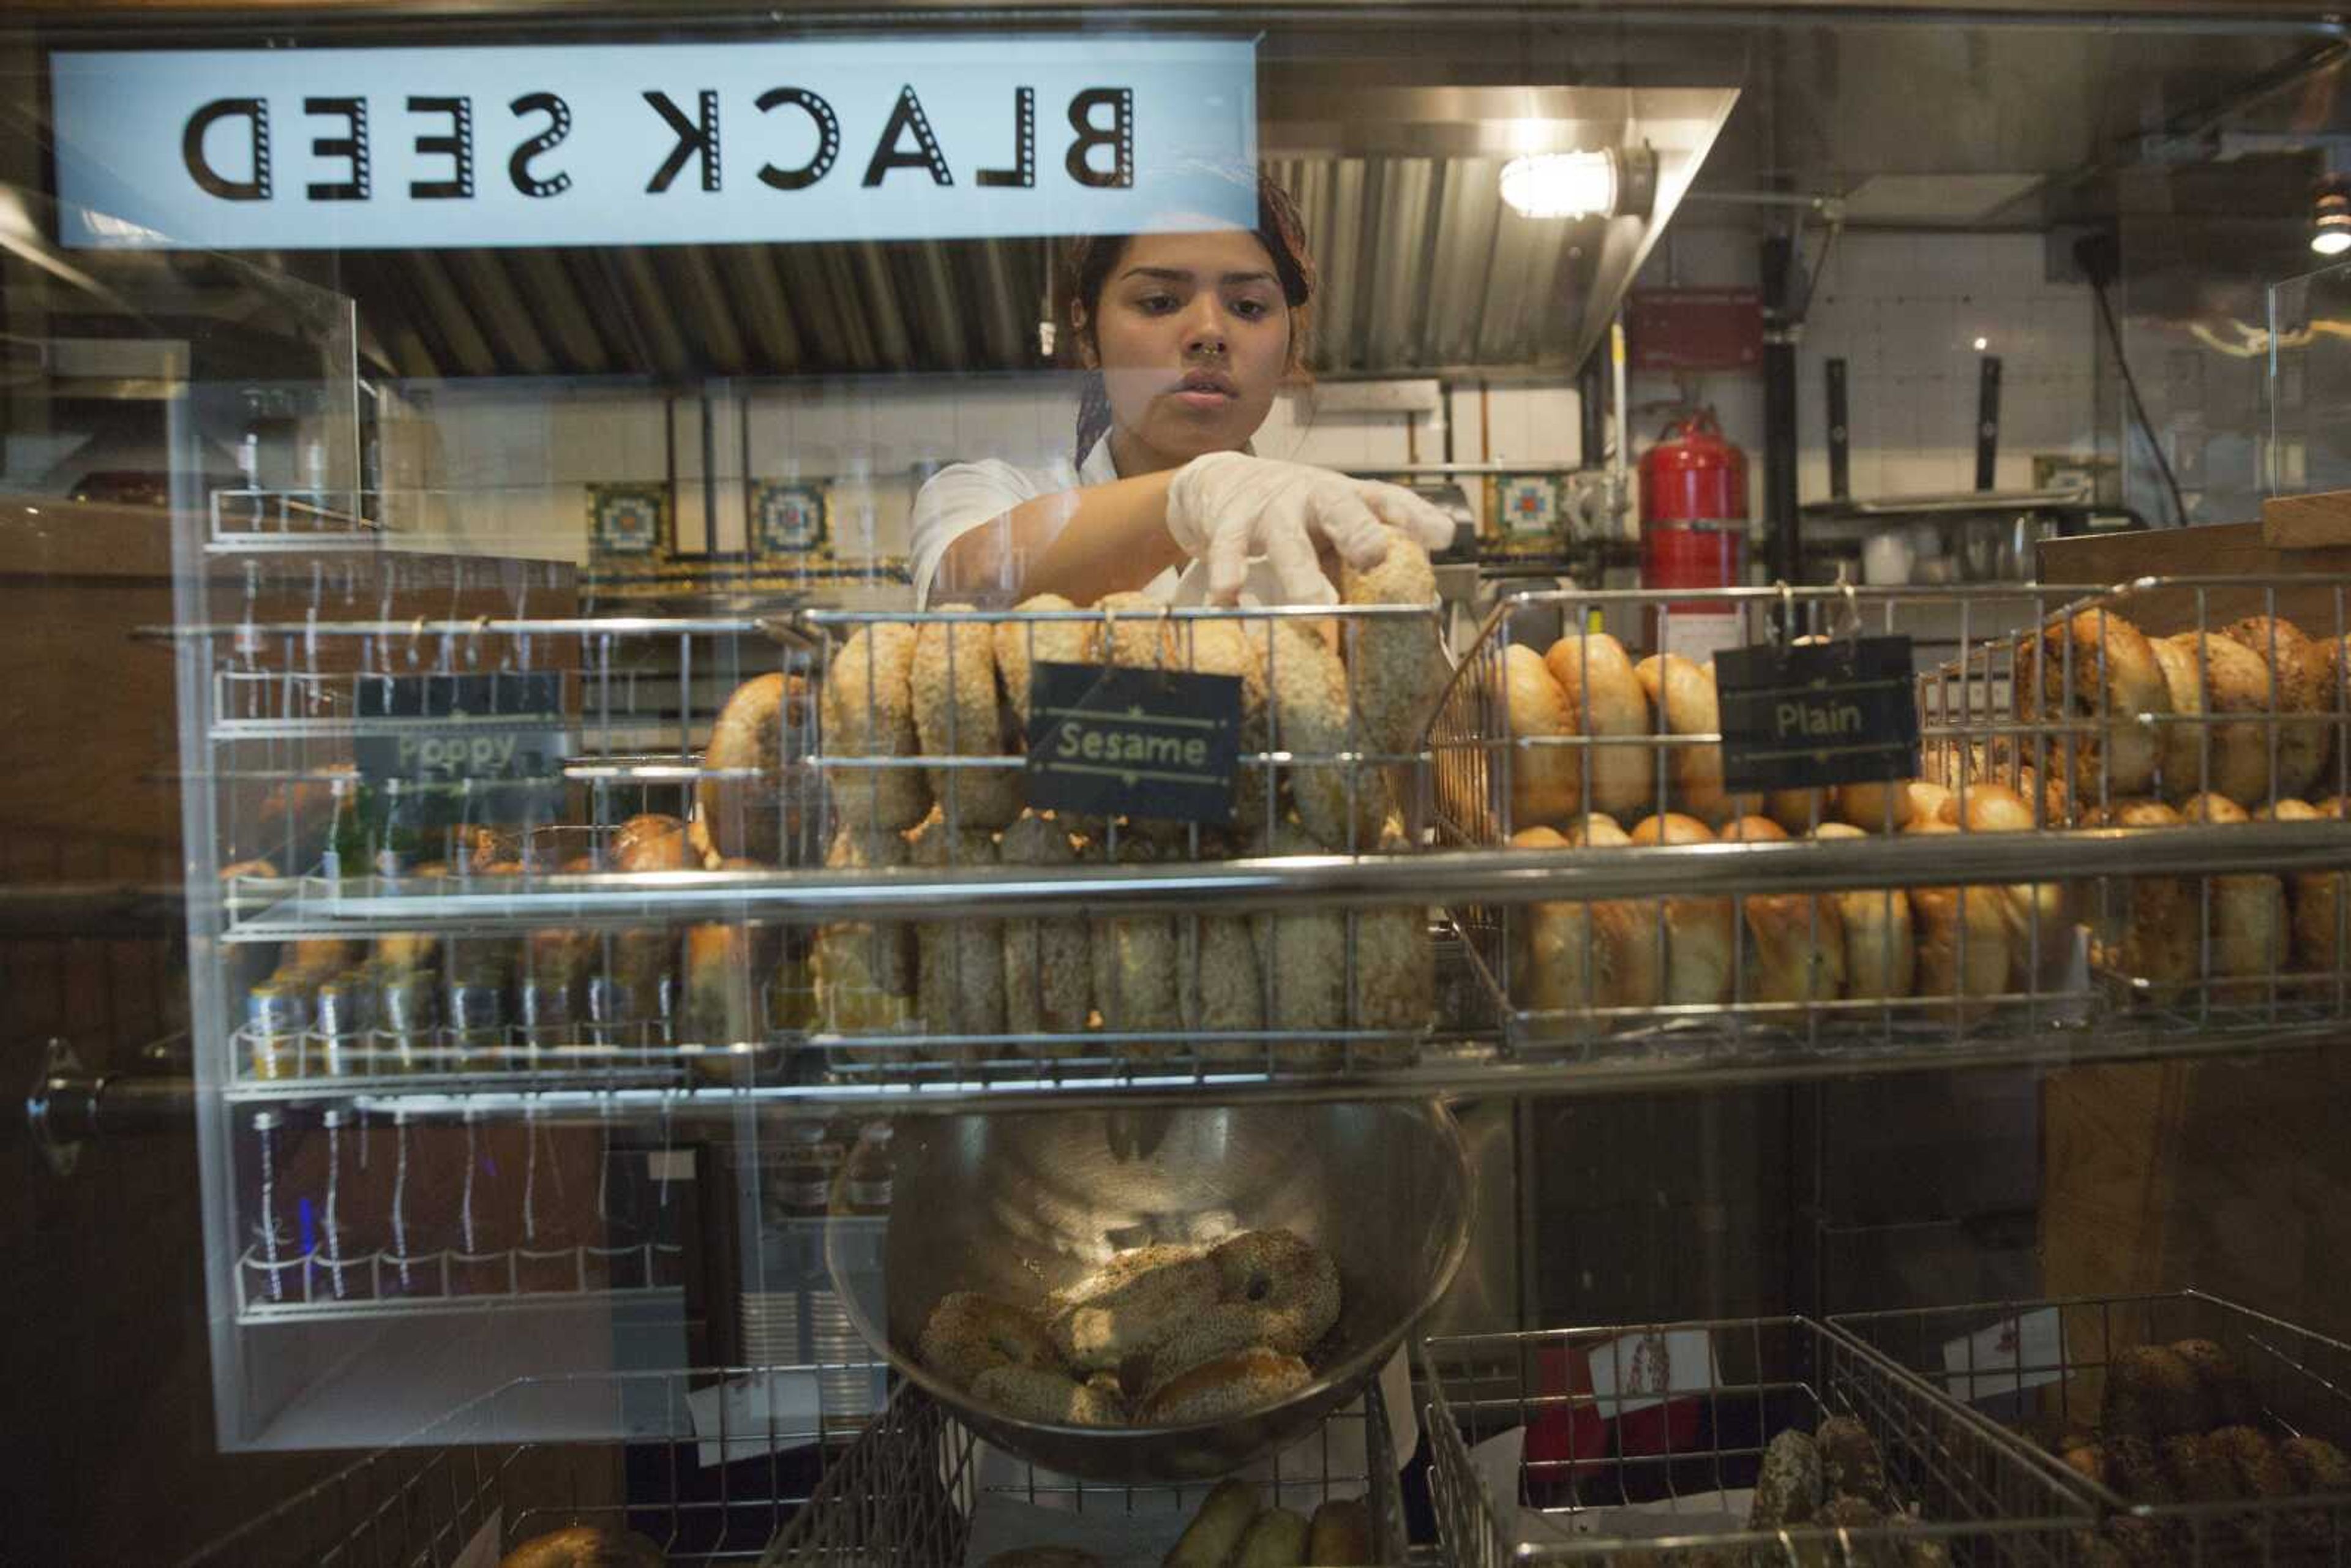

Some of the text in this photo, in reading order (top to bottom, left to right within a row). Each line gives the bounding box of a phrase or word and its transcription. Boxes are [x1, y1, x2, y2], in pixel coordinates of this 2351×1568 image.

[1777, 701, 1862, 738] Plain
[400, 734, 517, 774] Poppy
[1057, 722, 1208, 765] Sesame
